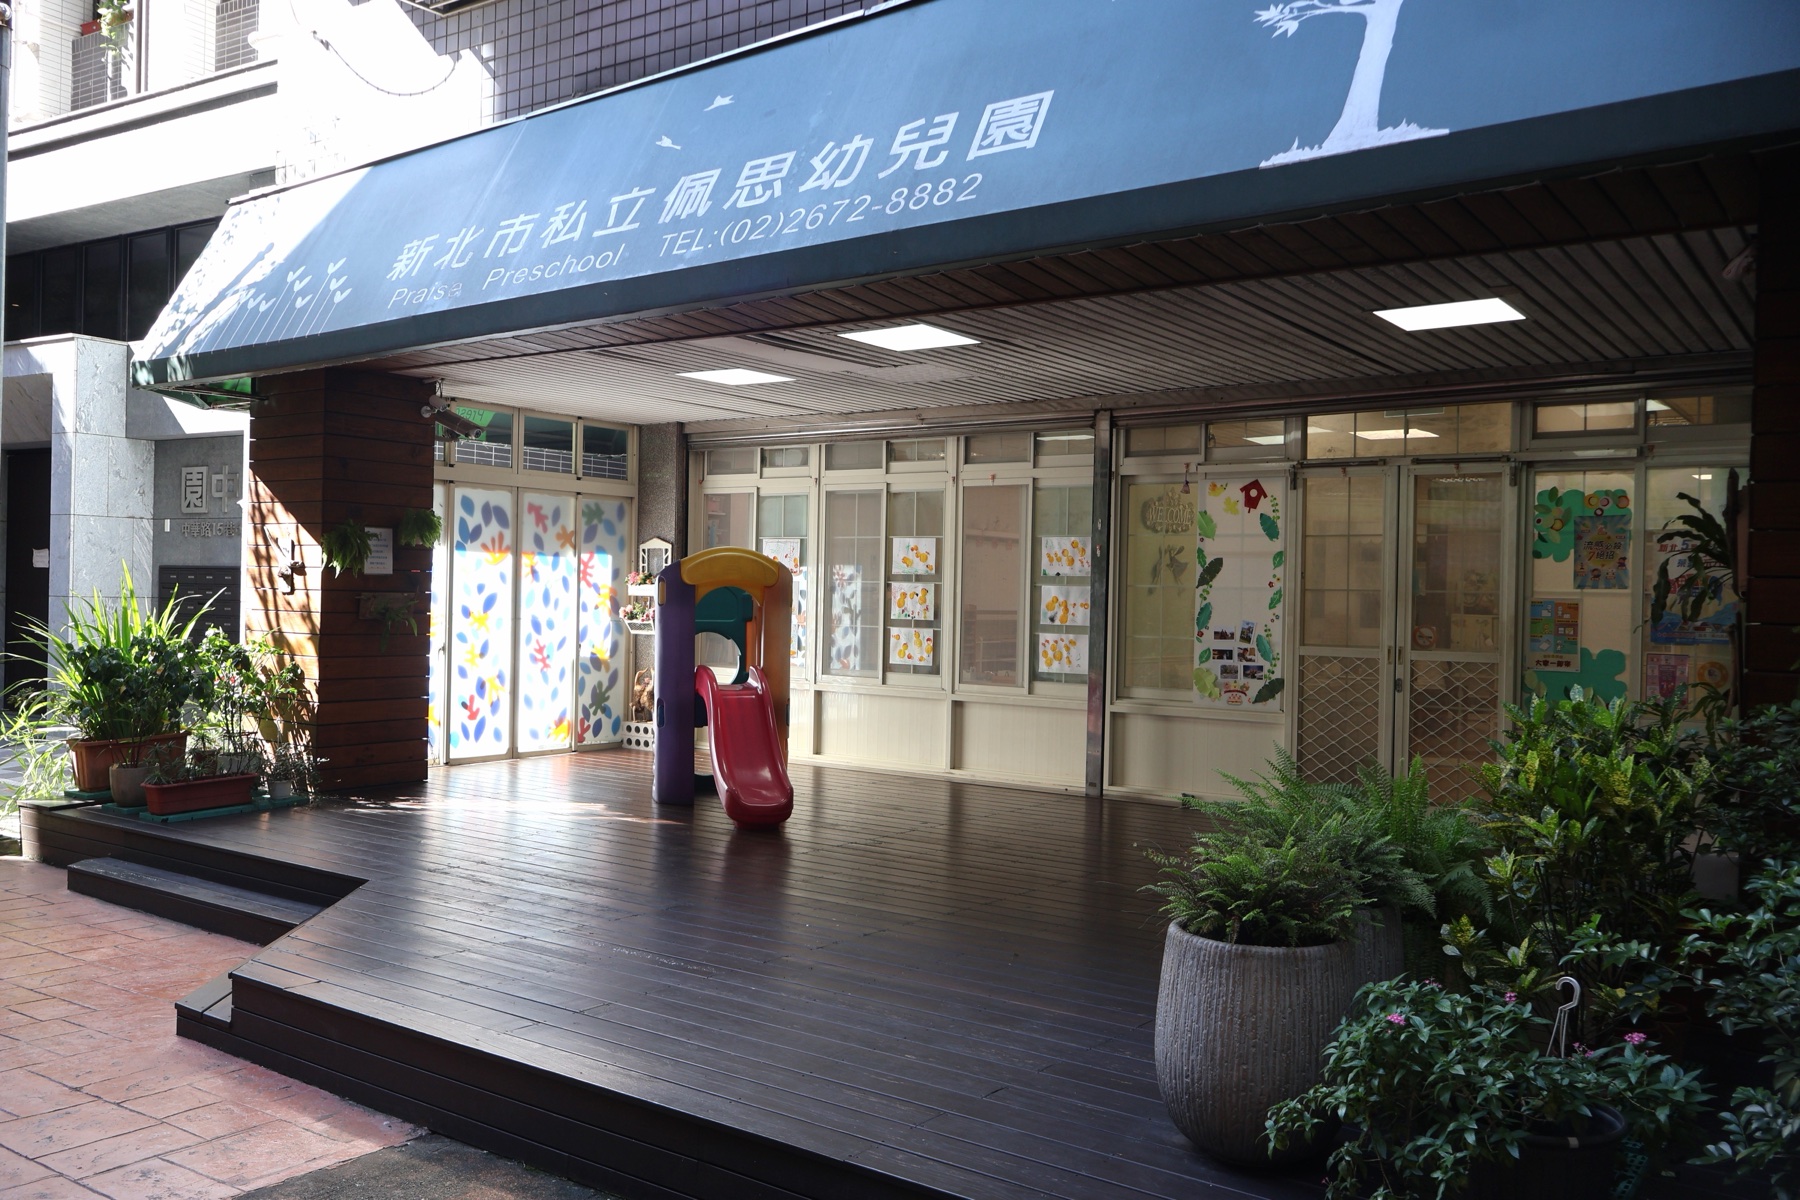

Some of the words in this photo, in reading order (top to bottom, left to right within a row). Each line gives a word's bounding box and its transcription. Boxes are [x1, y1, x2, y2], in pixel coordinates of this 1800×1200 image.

[386, 90, 1055, 281] 新北市私立佩思幼兒園
[388, 282, 463, 309] Praise
[482, 244, 625, 290] Preschool
[659, 173, 983, 257] TEL:(02)2672-8882
[1149, 506, 1192, 524] WELCOME
